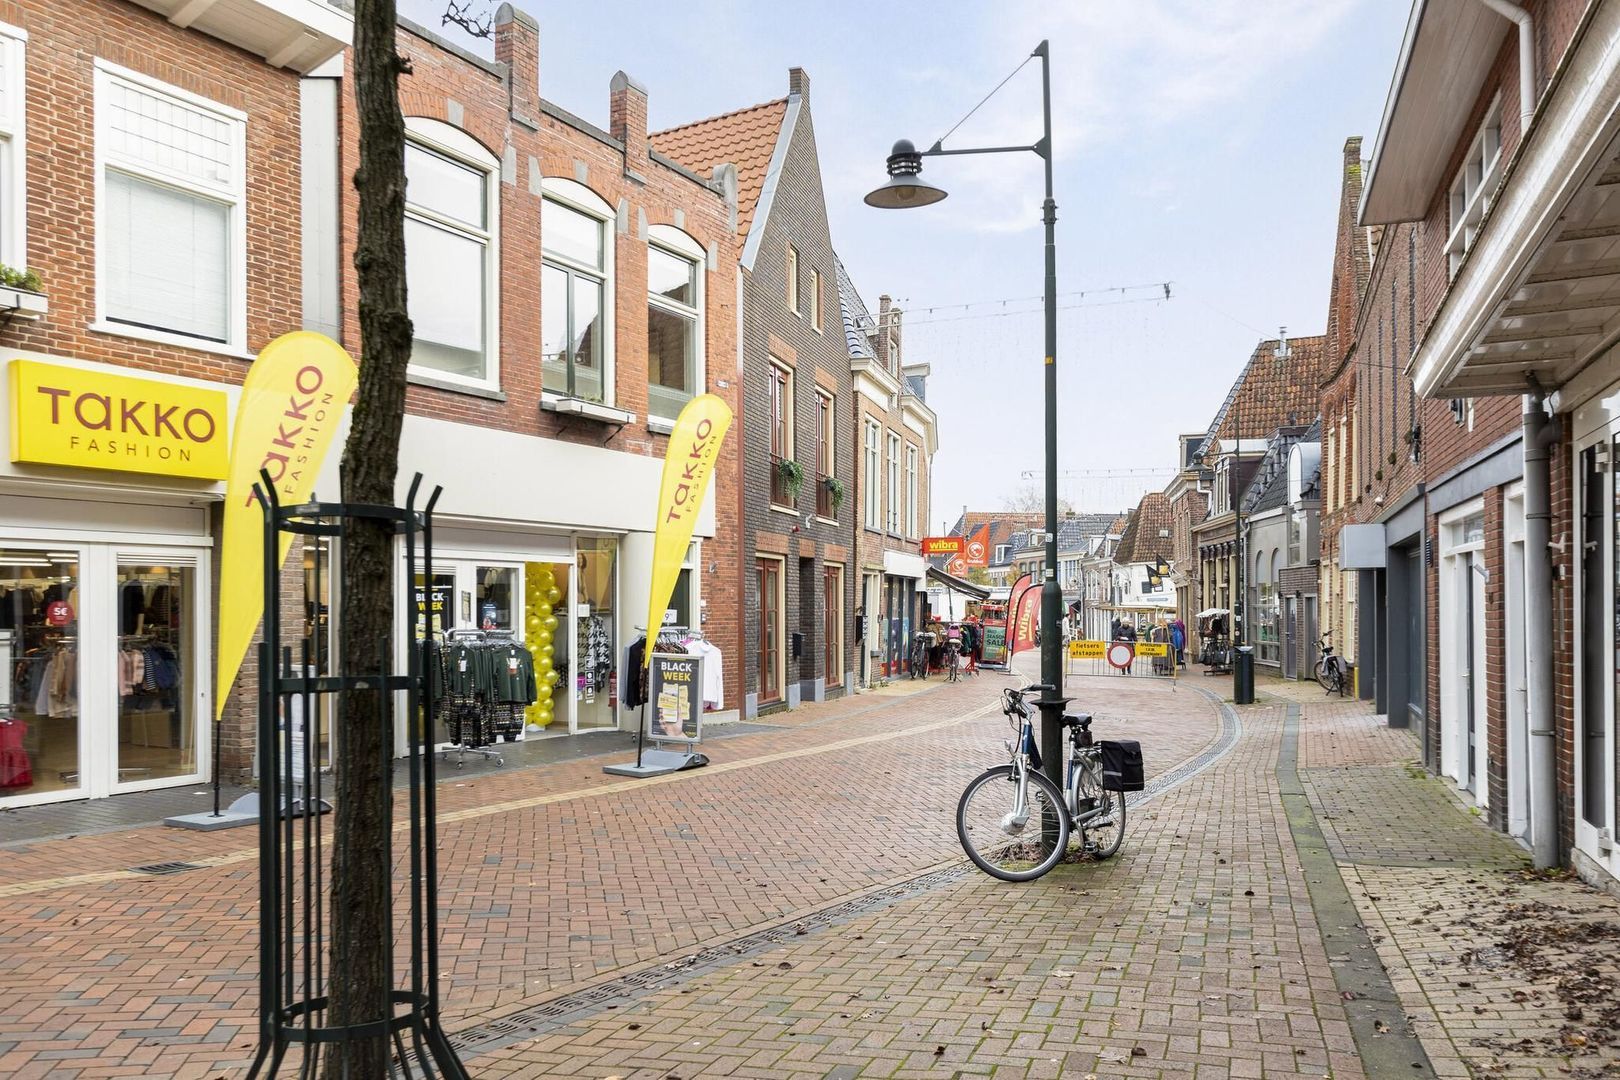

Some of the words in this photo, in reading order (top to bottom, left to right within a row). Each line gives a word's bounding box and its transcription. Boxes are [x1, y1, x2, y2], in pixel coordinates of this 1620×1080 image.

[70, 436, 191, 462] FASHION
[284, 393, 334, 495] FASHION
[929, 540, 958, 549] wibra
[415, 593, 444, 602] BLCK
[418, 602, 443, 610] WEK
[661, 661, 693, 672] BLACK
[663, 671, 691, 681] WEEK
